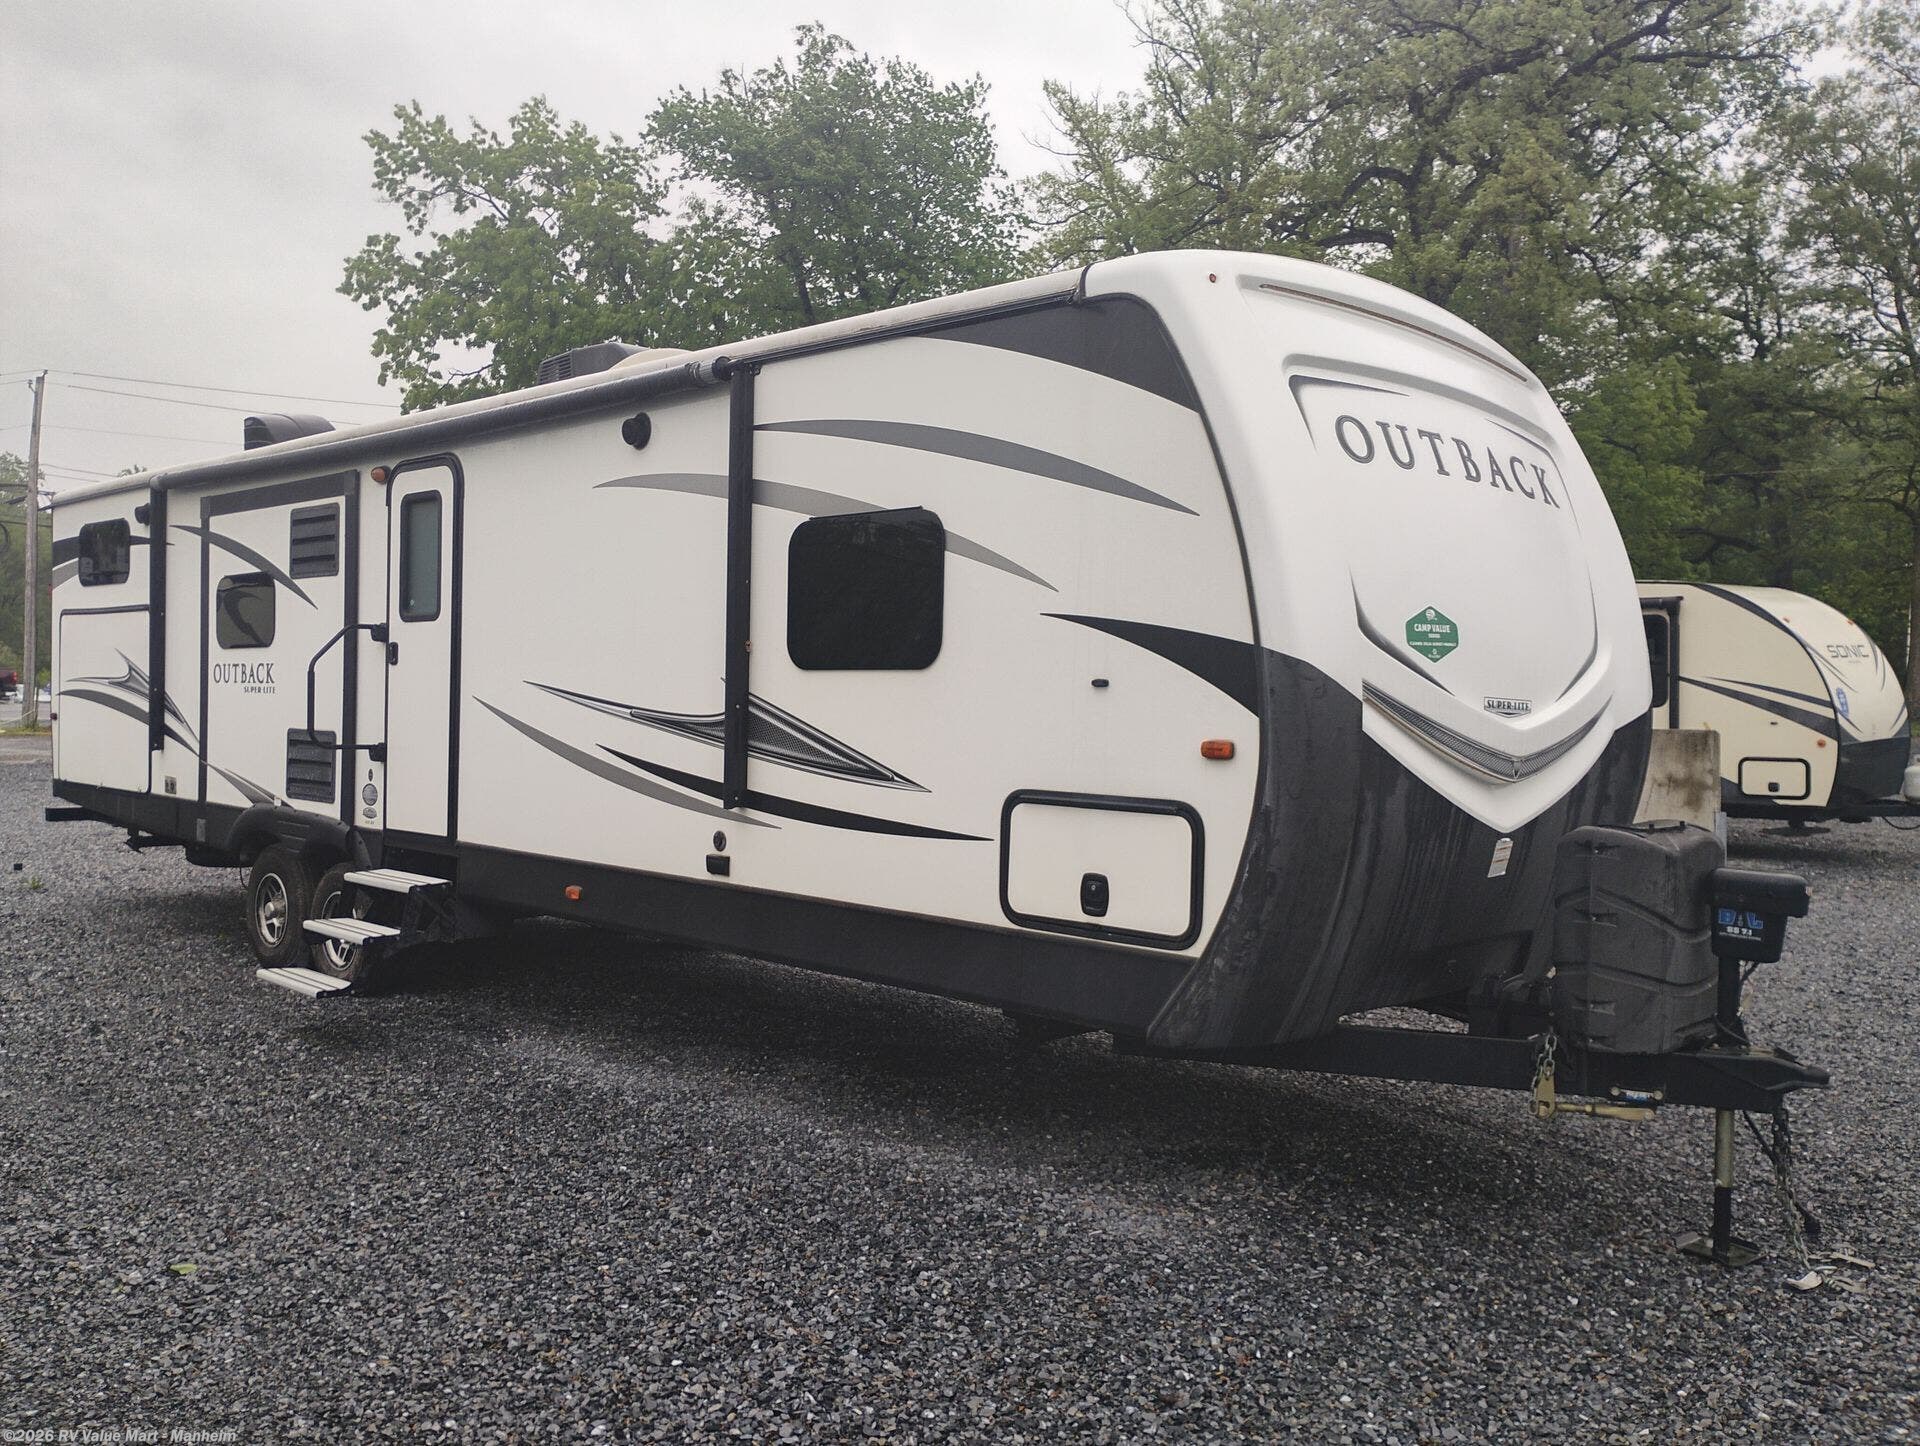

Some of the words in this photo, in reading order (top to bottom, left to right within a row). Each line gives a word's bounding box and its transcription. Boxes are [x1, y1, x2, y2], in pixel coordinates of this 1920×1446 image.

[1335, 414, 1560, 509] OUTBACK
[1413, 623, 1432, 632] CAMP
[1826, 644, 1869, 659] SONIC
[213, 663, 275, 684] OUTBACK
